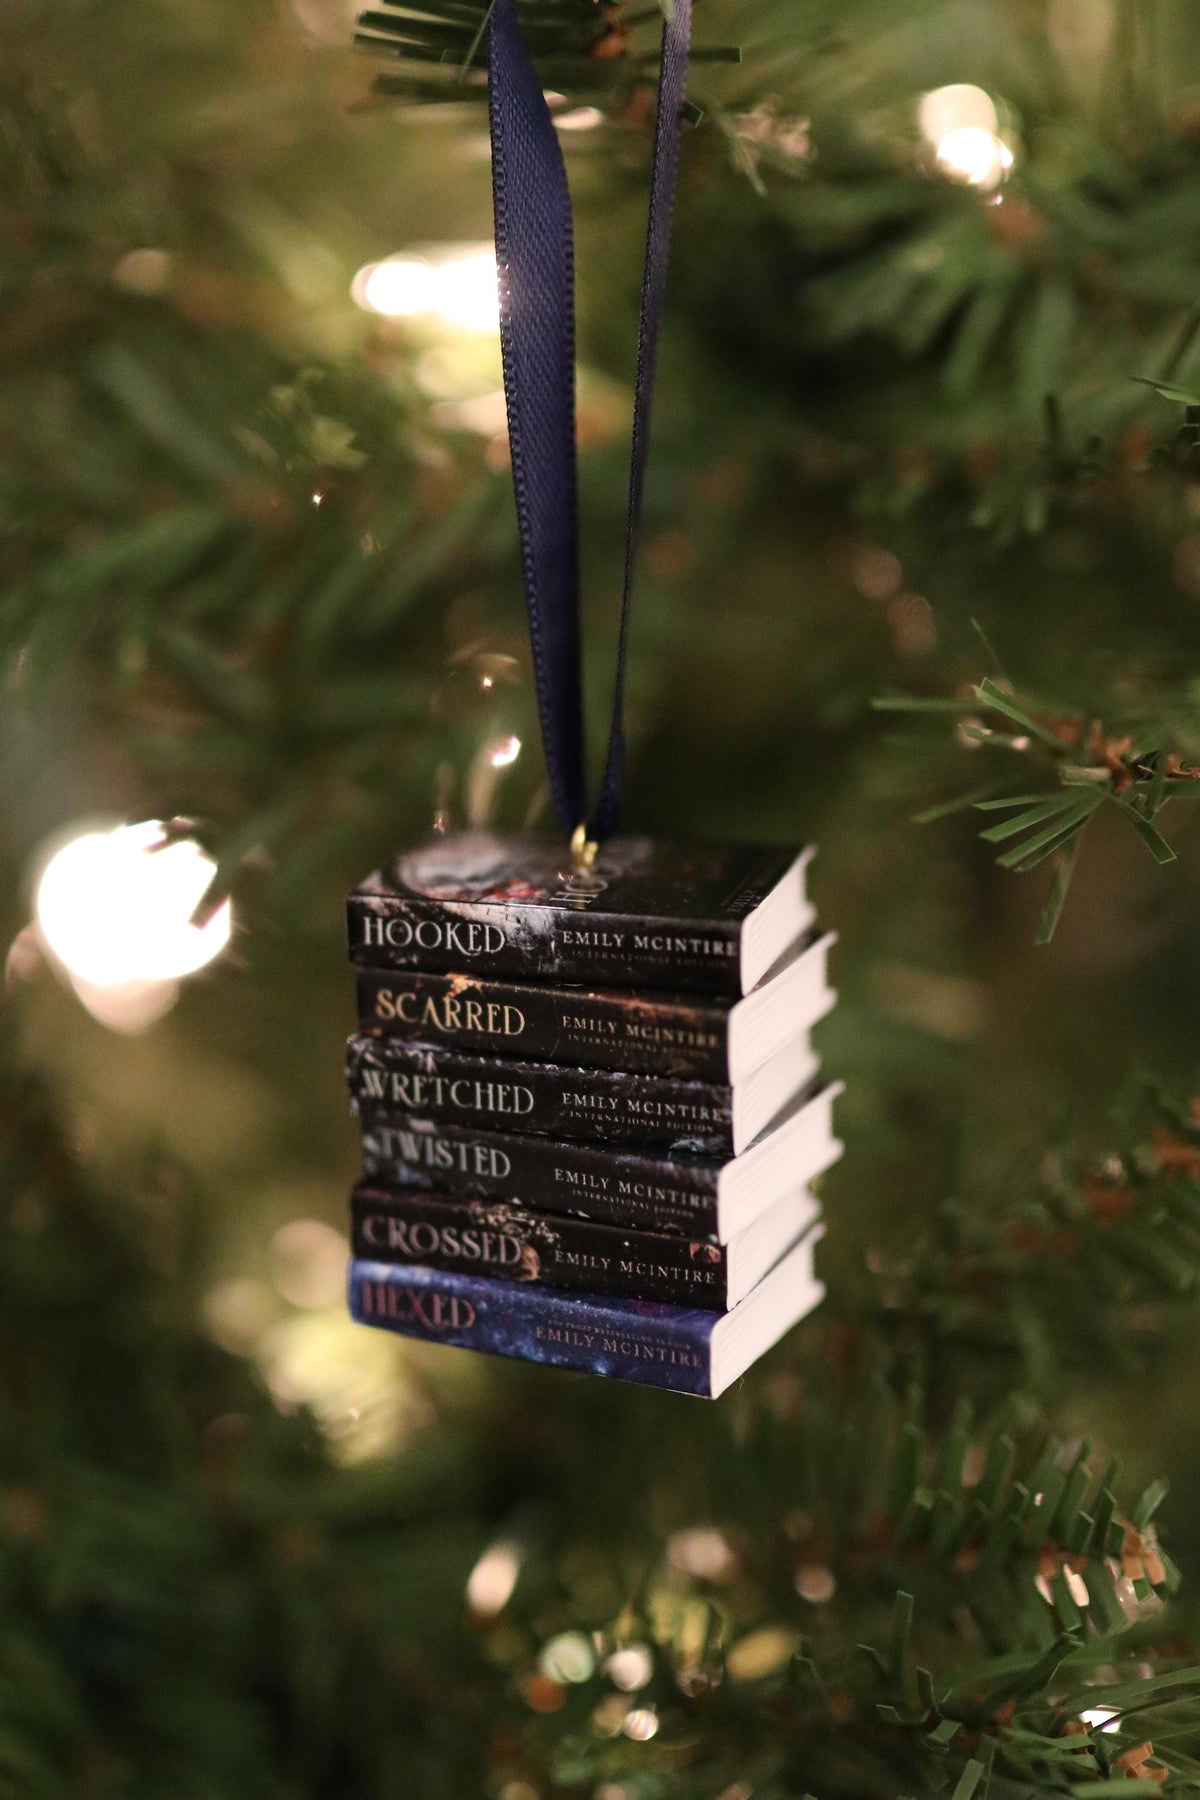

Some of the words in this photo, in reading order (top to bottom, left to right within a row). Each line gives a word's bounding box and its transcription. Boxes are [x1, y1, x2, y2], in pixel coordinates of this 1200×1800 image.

[363, 916, 506, 957] HOOKED
[562, 931, 625, 947] EMILY
[634, 935, 738, 957] MCINTIRE
[375, 988, 526, 1036] SCARRED
[562, 1015, 618, 1034] EMILY
[626, 1024, 719, 1048] MCINTIRE
[361, 1069, 535, 1114] WRETCHED
[562, 1092, 618, 1111] EMILY
[627, 1099, 724, 1122] MCINTIRE
[377, 1127, 512, 1179] TWISTED
[554, 1168, 609, 1190] EMILY
[618, 1180, 713, 1209] MCINTIRE
[362, 1215, 522, 1265] CROSSED
[555, 1250, 611, 1270] EMILY
[620, 1260, 716, 1285] MCINTIRE
[362, 1279, 476, 1332] HEXED
[535, 1326, 594, 1348] EMILY
[603, 1338, 701, 1368] MCINTIRE
